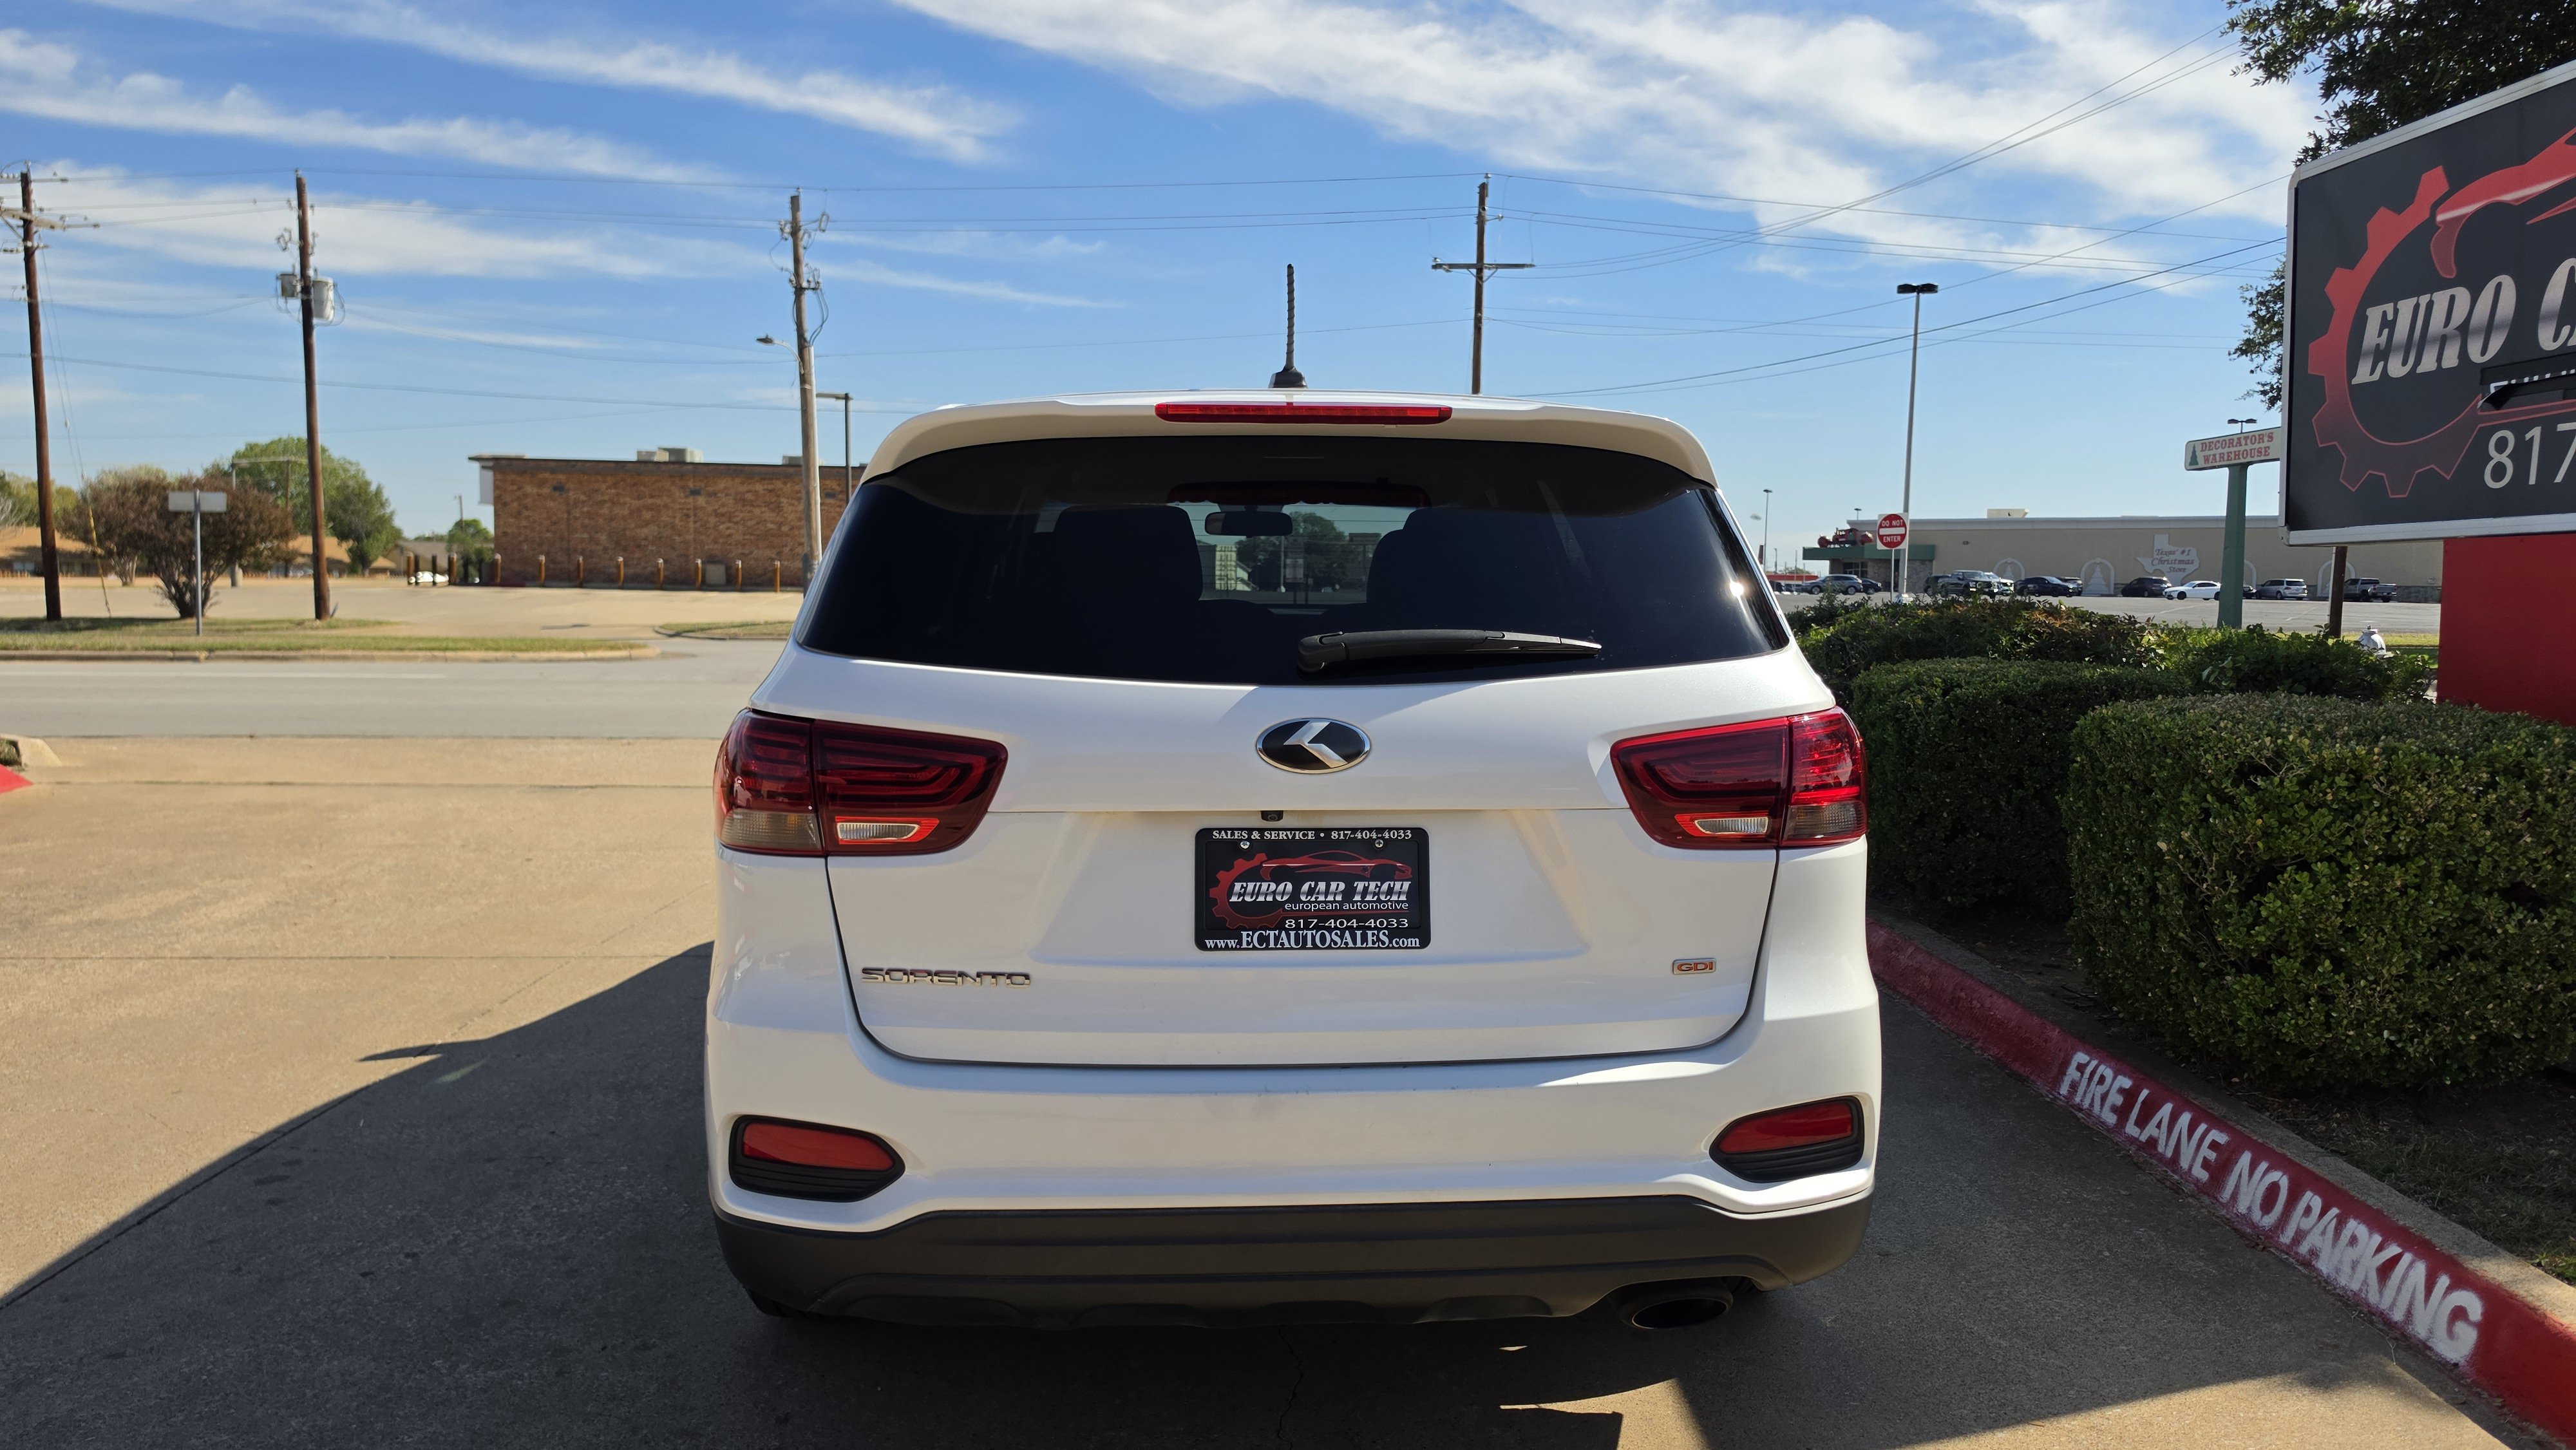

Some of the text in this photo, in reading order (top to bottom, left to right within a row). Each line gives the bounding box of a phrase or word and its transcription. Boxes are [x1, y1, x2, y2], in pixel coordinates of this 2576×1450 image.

[2352, 258, 2576, 384] EURO C
[2200, 431, 2274, 452] DECORATOR'S
[2203, 446, 2270, 464] WAREHOUSE
[2152, 557, 2195, 566] Christmas
[1213, 829, 1412, 840] SALES & SERVICE 817-404-4033
[1229, 881, 1411, 902] EURO CAR TECH
[1285, 901, 1408, 912] european automotive
[1285, 918, 1408, 928] 817-404-4033
[1205, 929, 1420, 949] www.ECTAUTOSALES.com
[1677, 961, 1713, 972] GDI
[861, 967, 1031, 988] SORENTO
[2060, 1051, 2484, 1364] FIRE LANE NO PARKING
